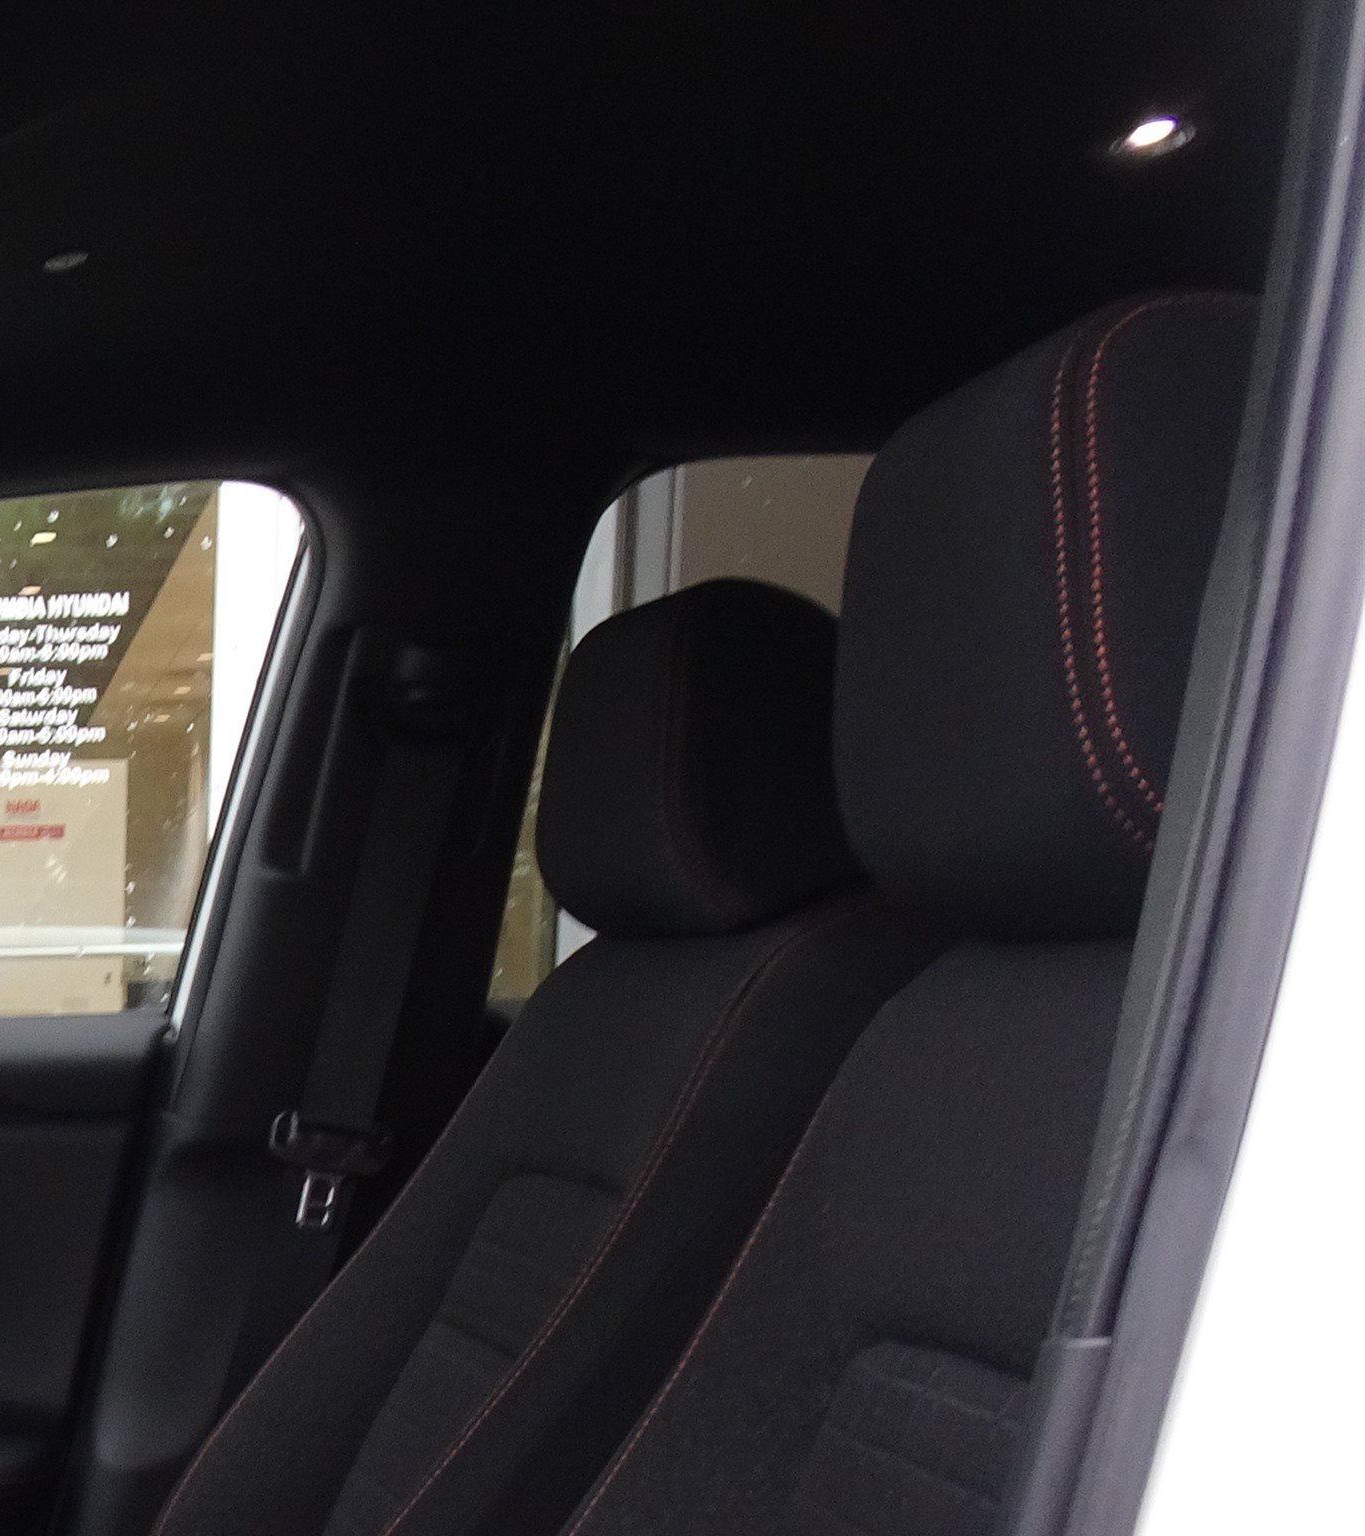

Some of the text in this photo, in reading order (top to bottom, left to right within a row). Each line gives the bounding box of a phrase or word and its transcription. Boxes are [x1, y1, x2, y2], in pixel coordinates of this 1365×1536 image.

[47, 591, 130, 619] HYUNDAI
[8, 667, 67, 688] Friday
[1, 749, 71, 770] Sunday
